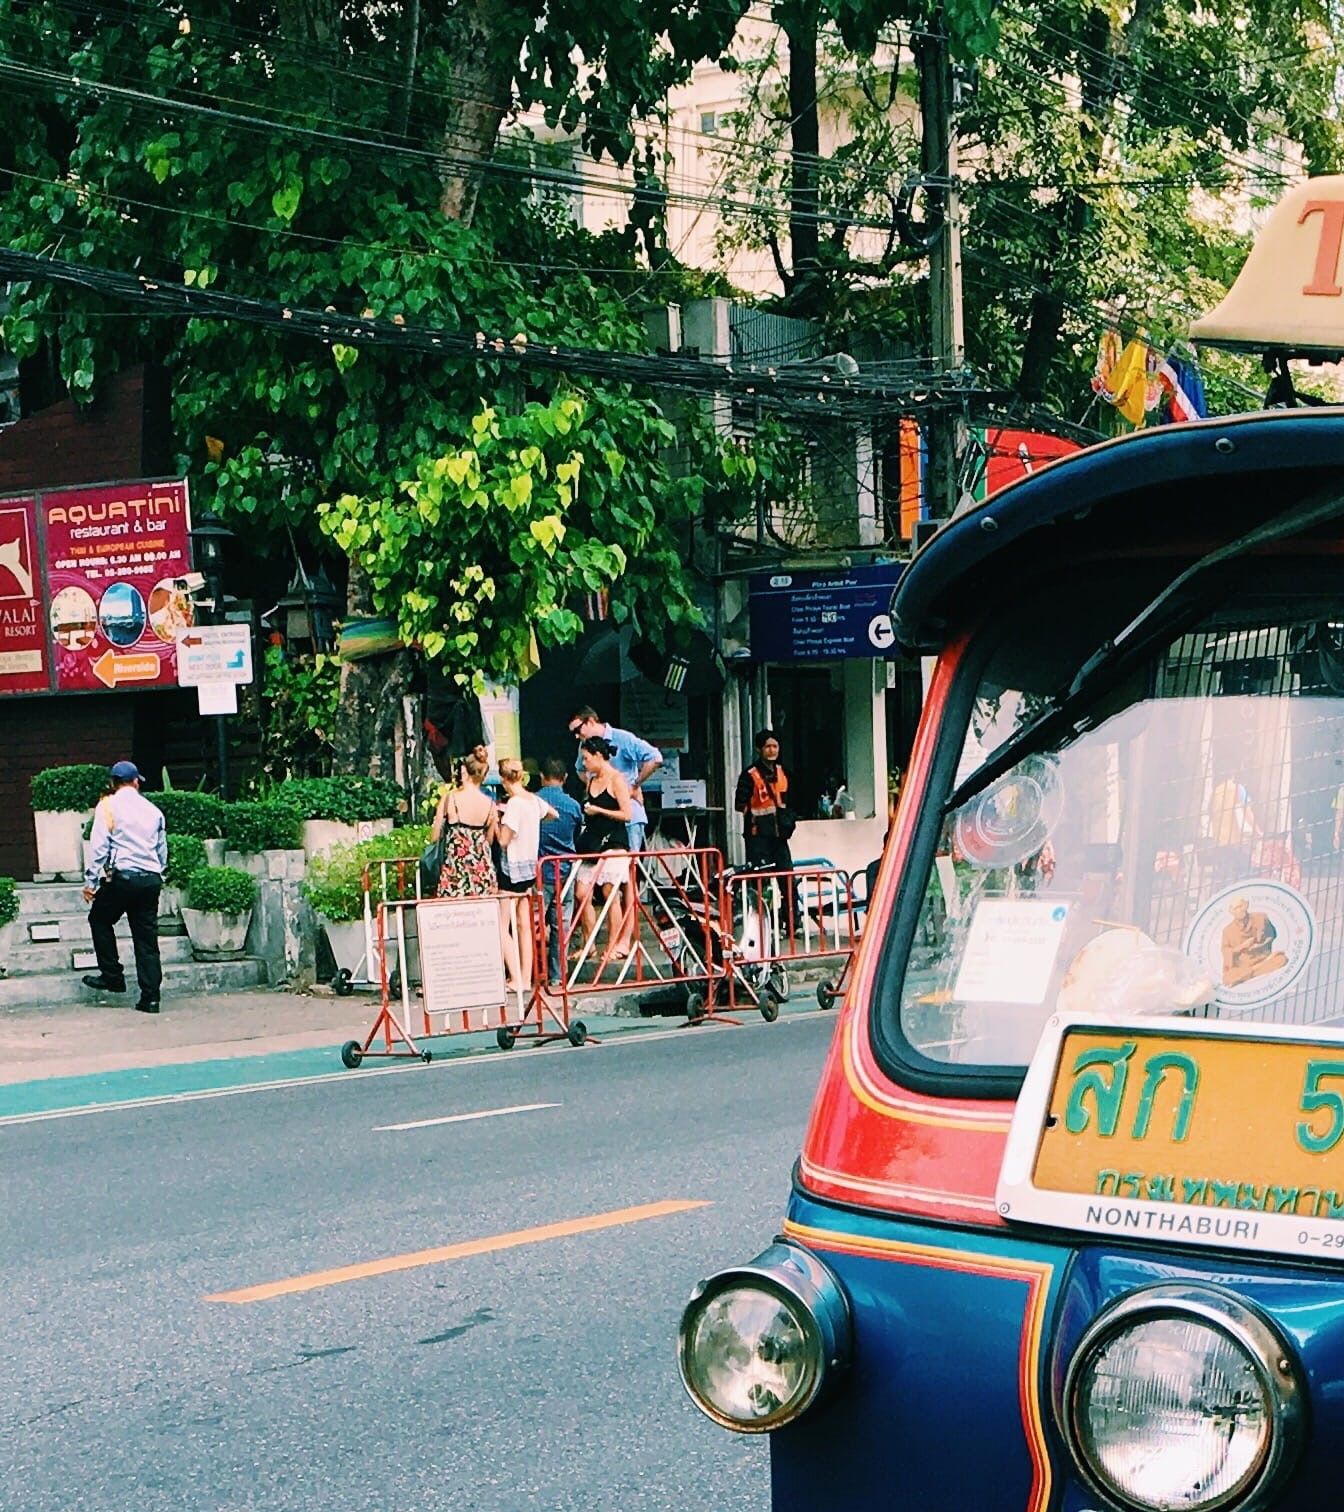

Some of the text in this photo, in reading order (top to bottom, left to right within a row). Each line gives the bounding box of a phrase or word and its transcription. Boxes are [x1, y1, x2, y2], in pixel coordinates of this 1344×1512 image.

[70, 518, 167, 539] restaurant & bar
[55, 559, 77, 568] OPEN
[5, 625, 37, 637] RESORT
[1065, 1041, 1201, 1145] สก
[1085, 1205, 1260, 1241] NONTHABURI
